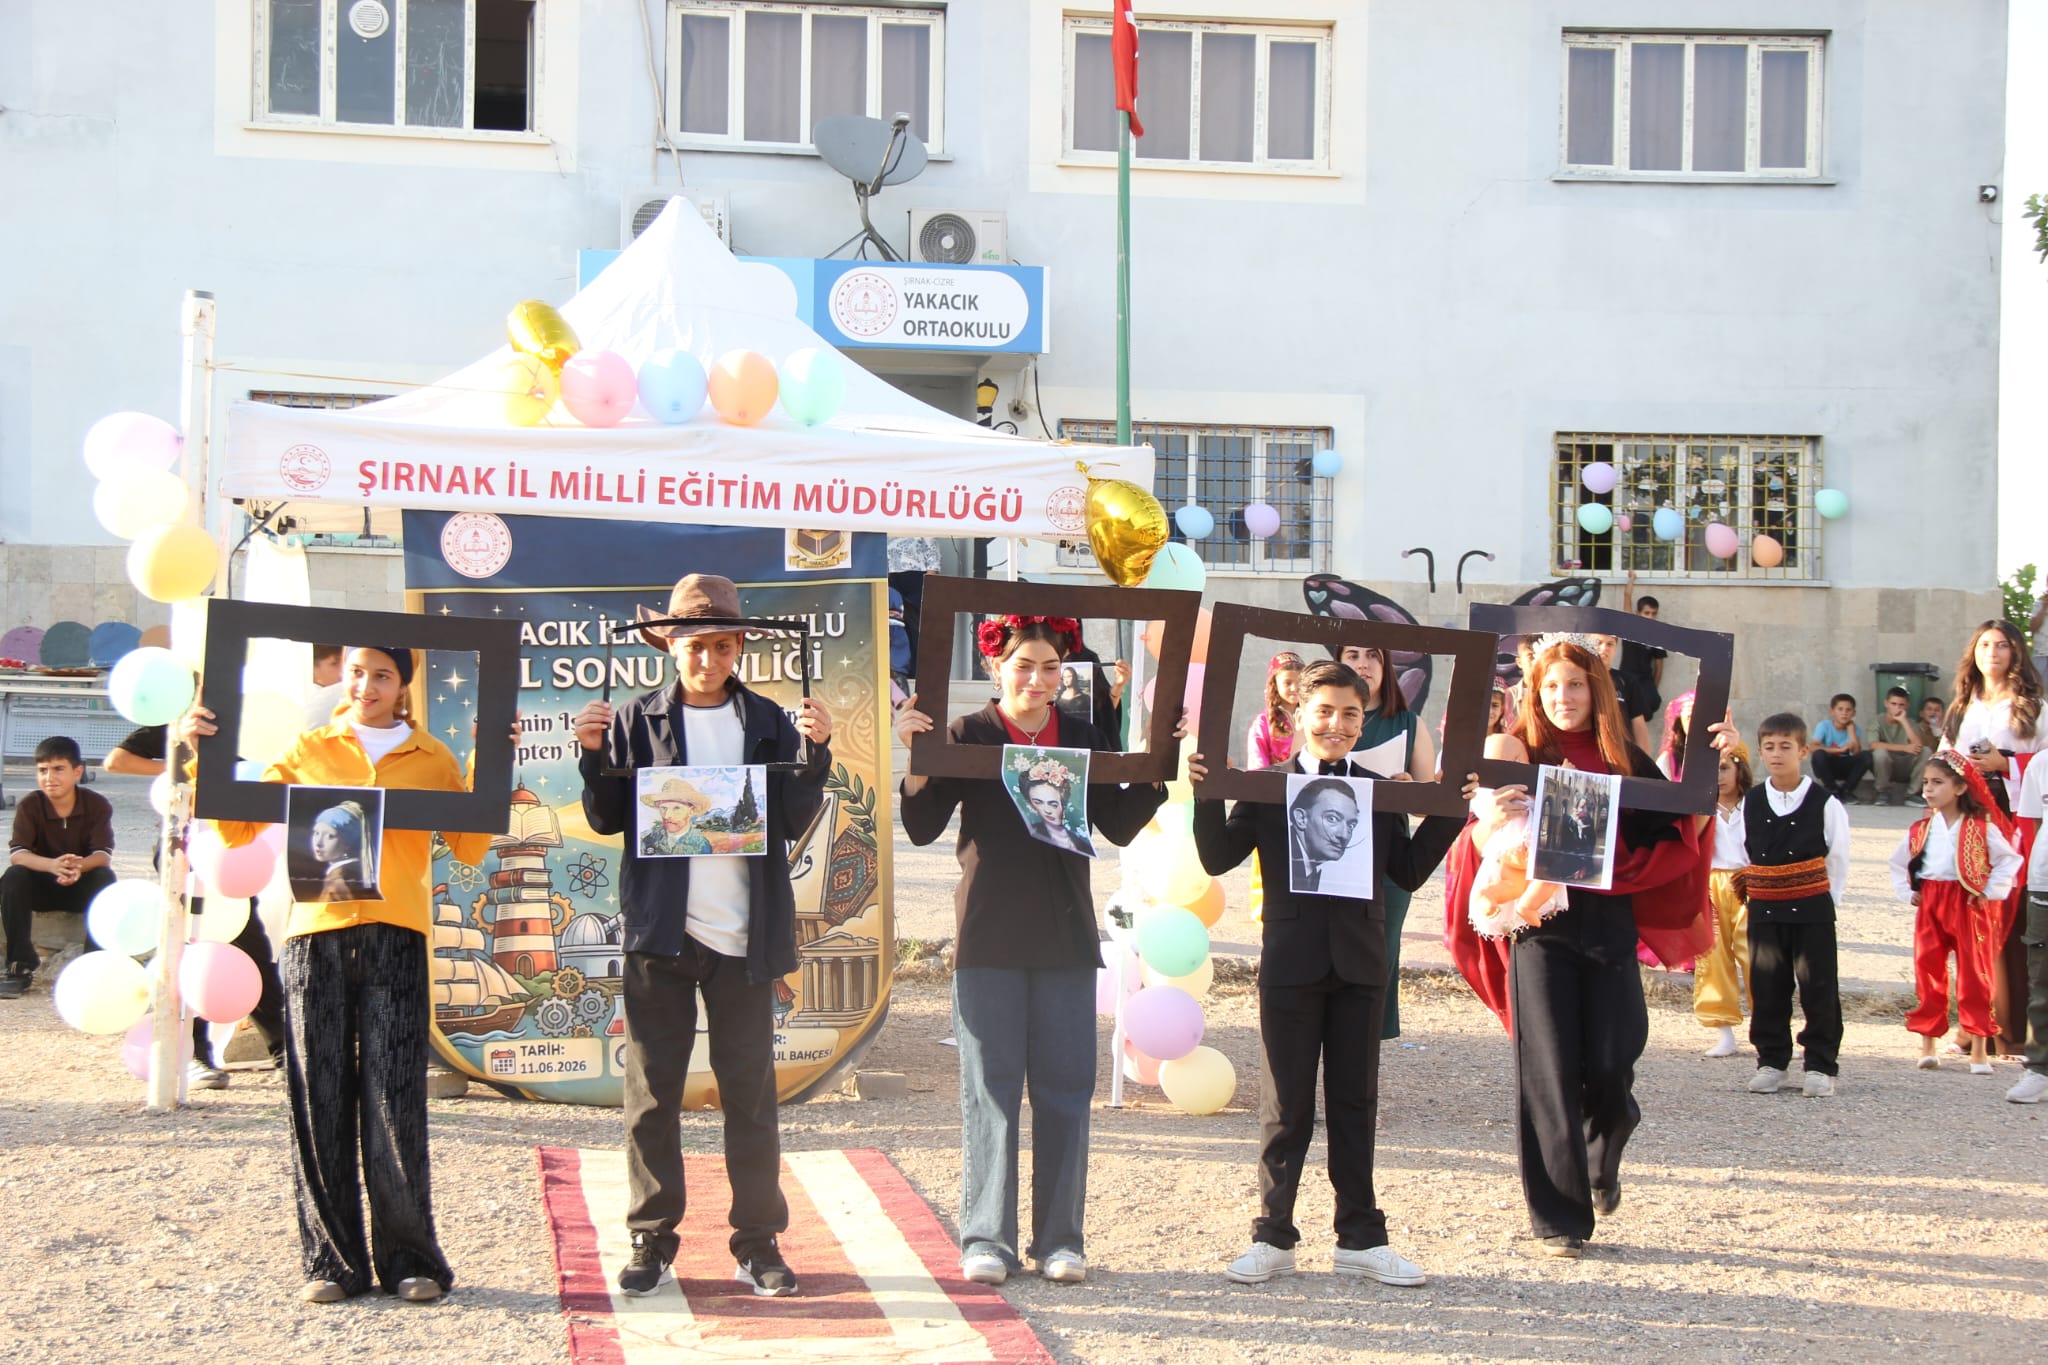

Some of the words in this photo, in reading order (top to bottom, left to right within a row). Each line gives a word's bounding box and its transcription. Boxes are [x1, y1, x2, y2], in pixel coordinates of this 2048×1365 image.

[903, 292, 979, 311] YAKACIK
[903, 319, 1011, 339] ORTAOKULU
[358, 460, 496, 497] ŞIRNAK
[507, 461, 538, 499] İL
[549, 465, 646, 504] MİLLİ
[658, 471, 781, 510] EĞİTİM
[793, 478, 1023, 522] MÜDÜRLÜĞÜ
[520, 621, 592, 646] ACIK
[552, 657, 665, 689] SONU
[731, 640, 824, 683] NLİĞİ
[520, 1042, 565, 1057] TARİH:
[520, 1060, 587, 1074] 11.06.2026
